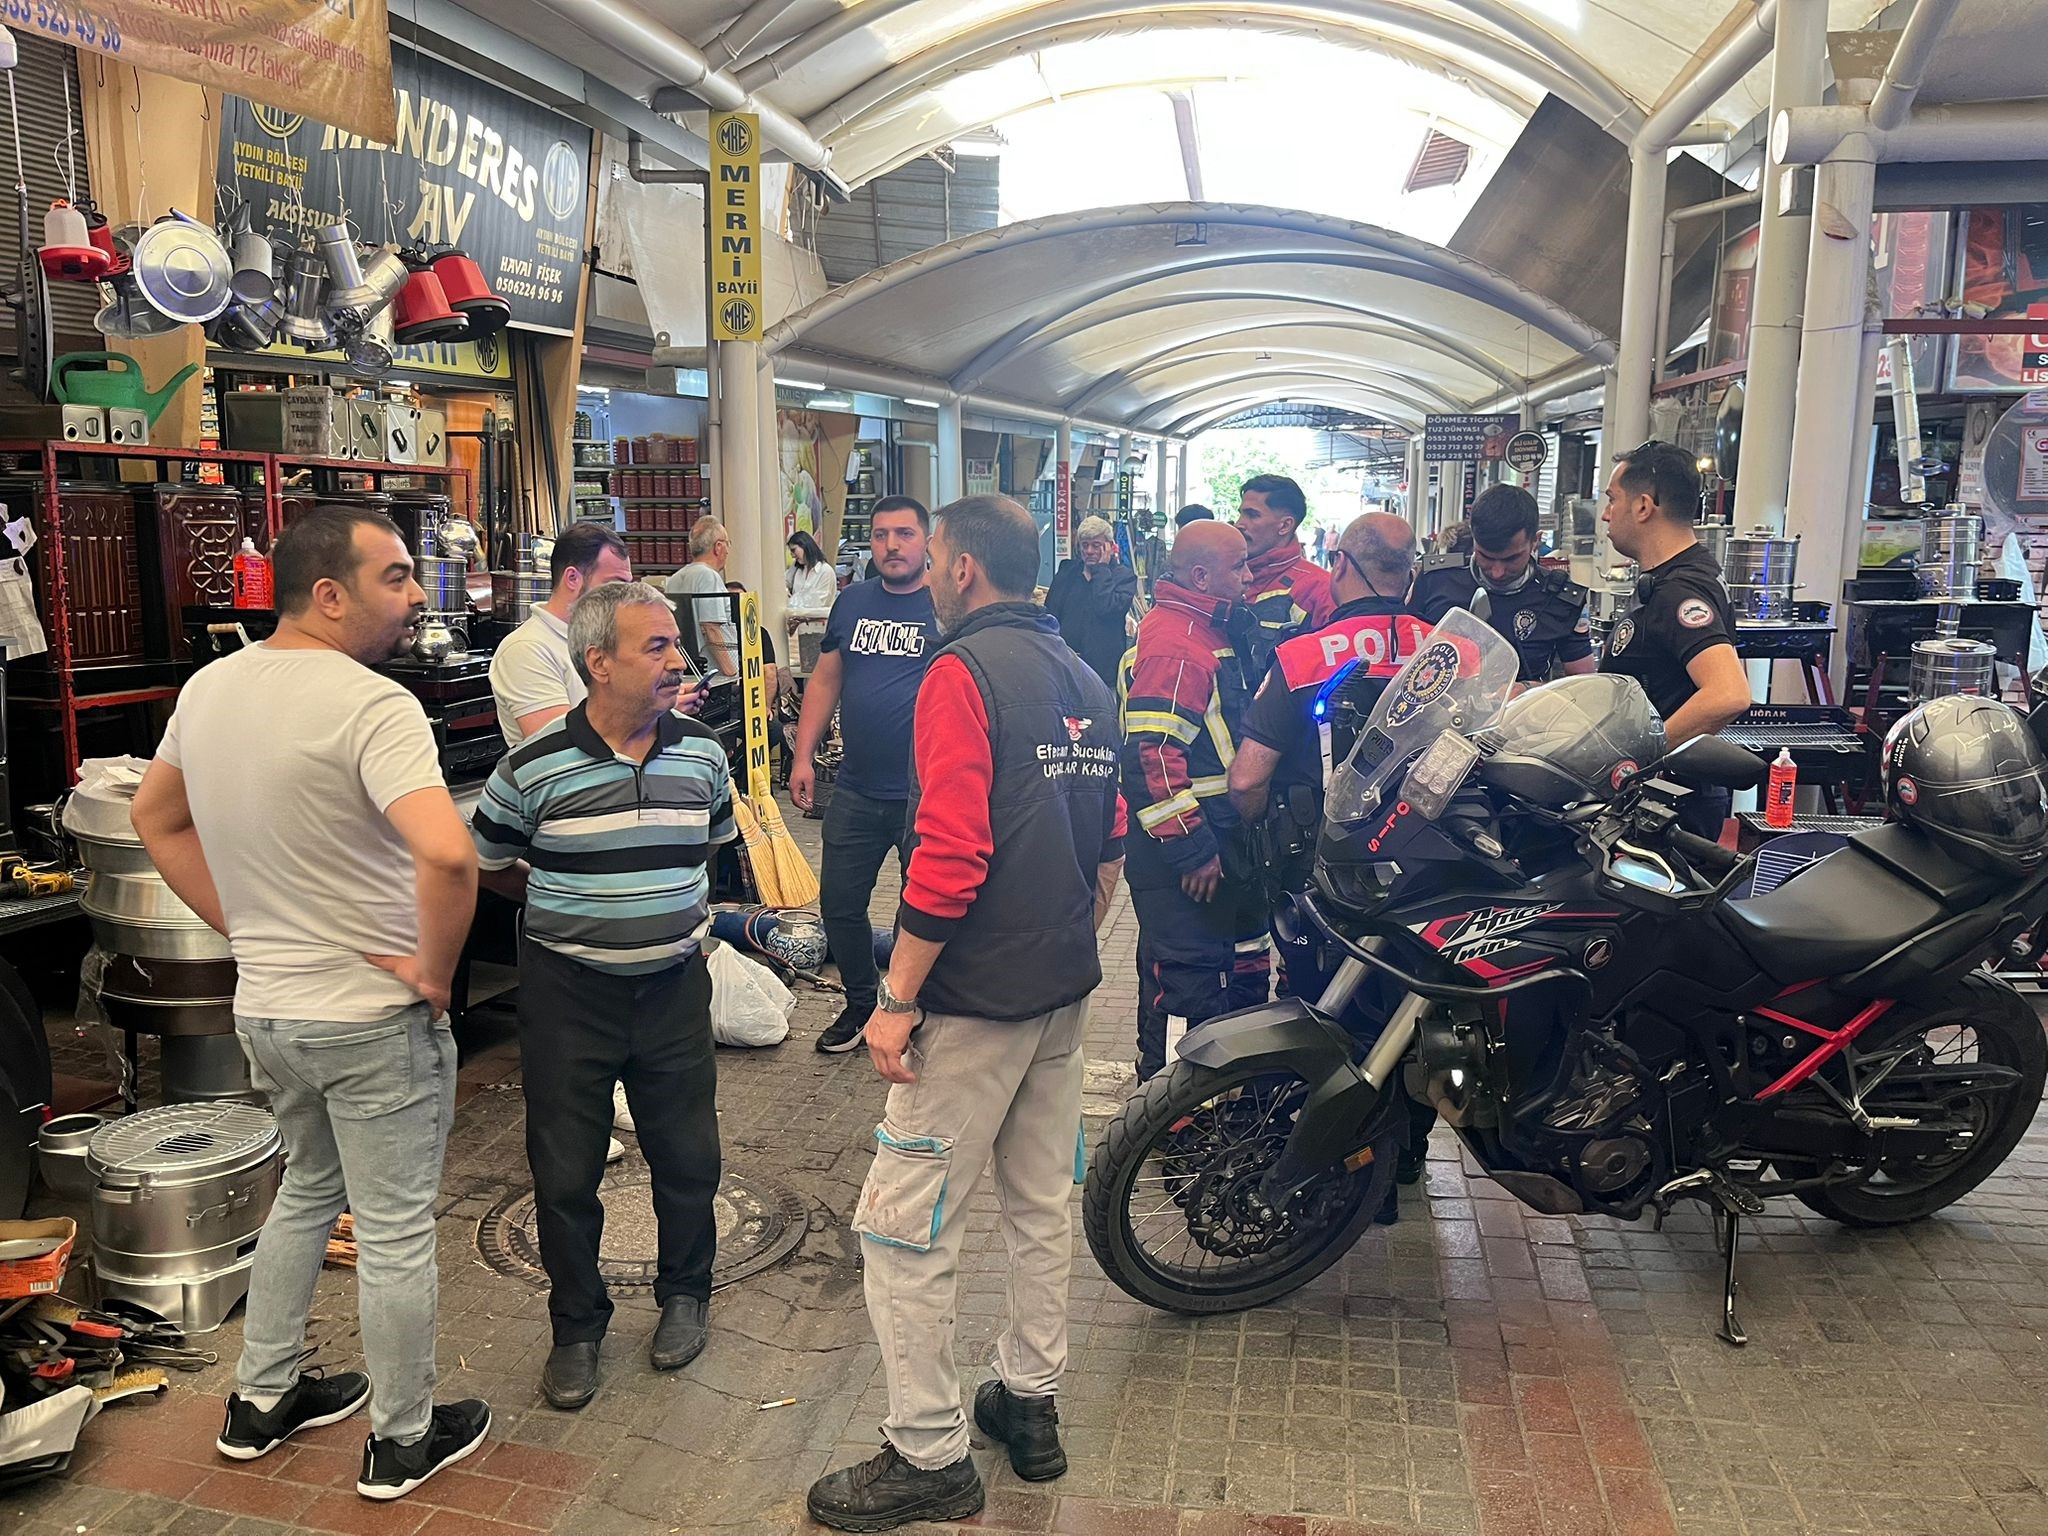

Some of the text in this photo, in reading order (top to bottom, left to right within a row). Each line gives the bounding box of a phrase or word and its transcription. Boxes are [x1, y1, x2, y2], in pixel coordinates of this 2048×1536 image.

[240, 42, 258, 75] 12
[233, 141, 263, 161] AYDIN
[235, 160, 274, 184] YETKİLİ
[407, 179, 475, 248] AV
[536, 262, 562, 286] FİŞEK
[1427, 416, 1505, 424] DÖNMEZ TİCARET
[1444, 425, 1480, 433] DÜNYASI
[1319, 623, 1424, 667] POLİ
[747, 656, 765, 769] MERM
